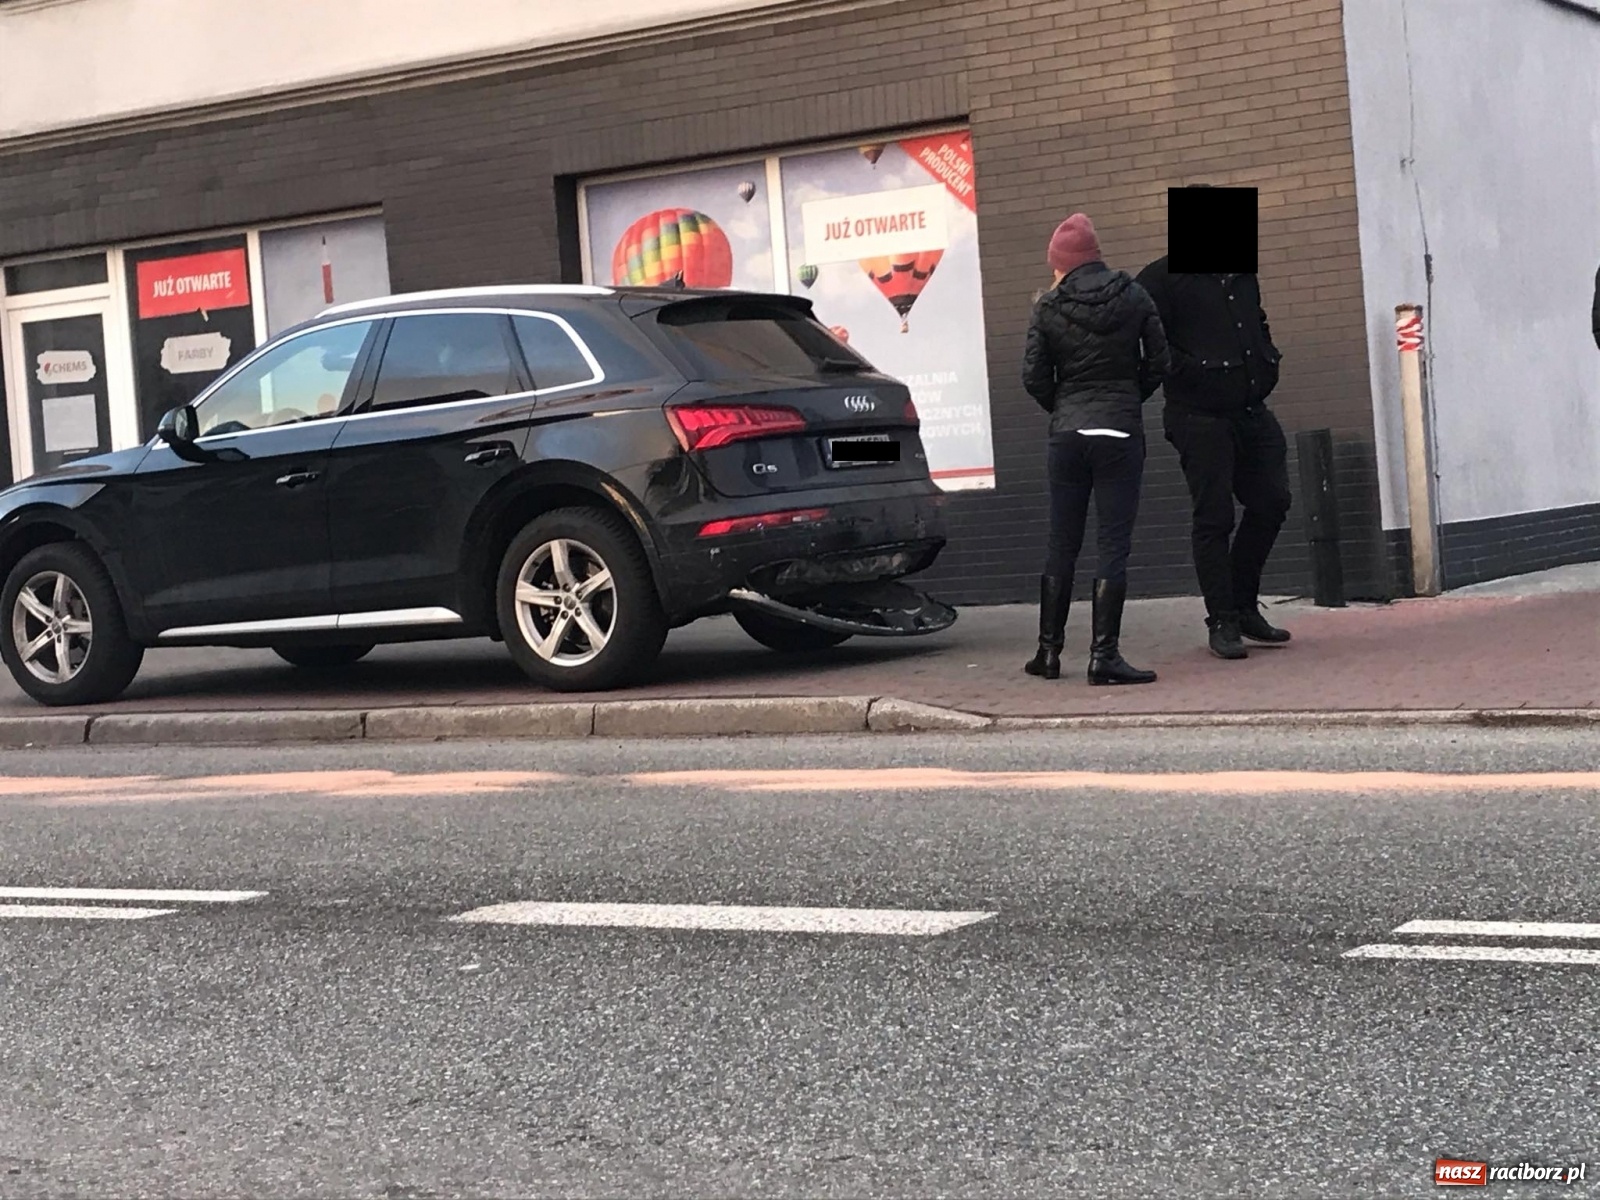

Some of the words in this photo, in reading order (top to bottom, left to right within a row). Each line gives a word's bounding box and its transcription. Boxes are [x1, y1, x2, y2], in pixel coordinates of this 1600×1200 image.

[918, 146, 973, 197] PRODUCENT
[937, 143, 972, 177] POLSKI
[825, 216, 852, 241] JUŻ
[854, 210, 926, 237] OTWARTE
[176, 271, 232, 294] OTWARTE
[178, 347, 213, 361] FARBY
